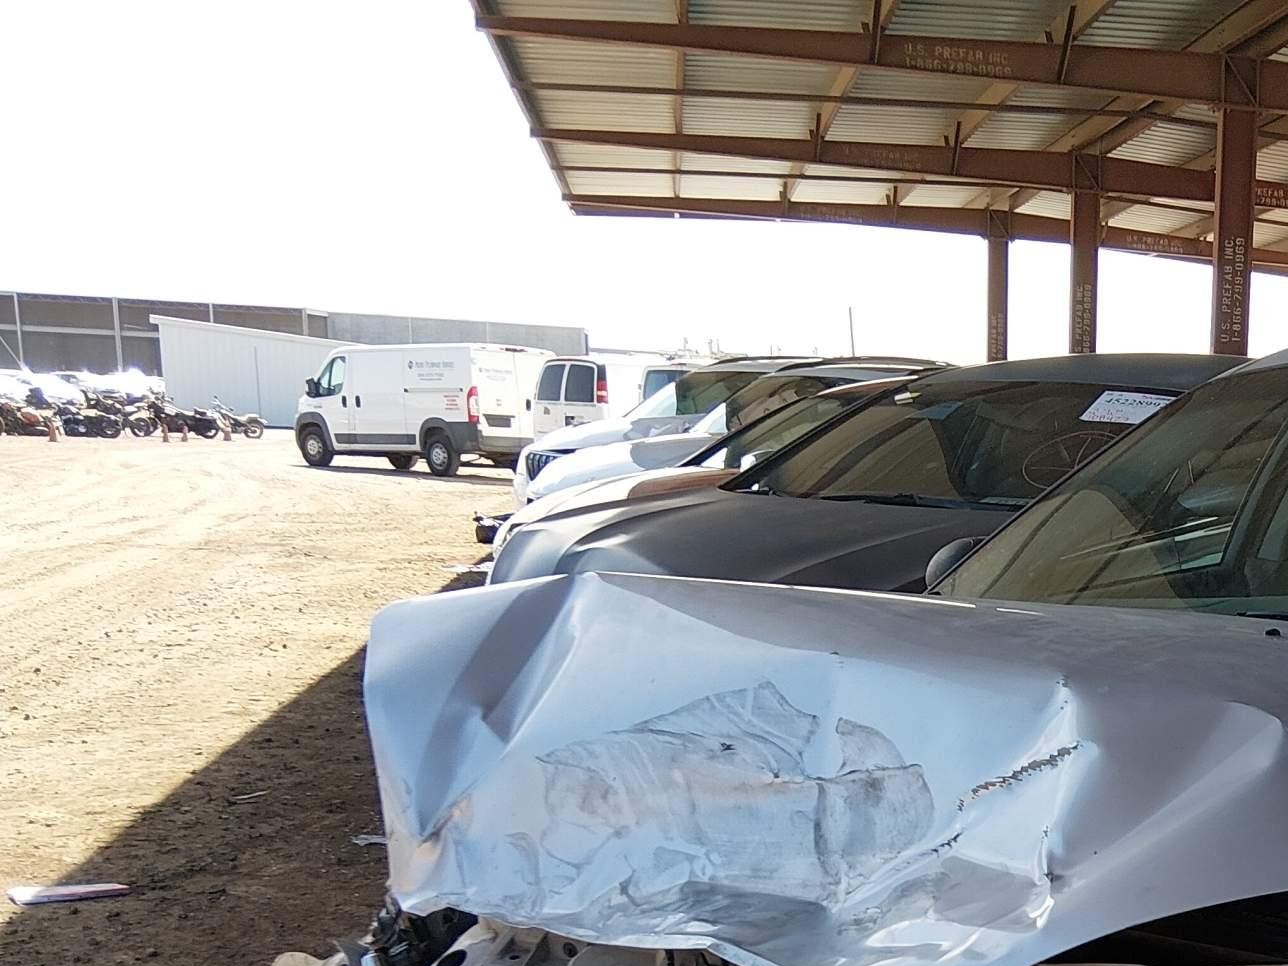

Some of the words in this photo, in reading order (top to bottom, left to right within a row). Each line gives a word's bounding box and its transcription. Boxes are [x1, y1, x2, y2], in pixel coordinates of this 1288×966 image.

[904, 43, 928, 57] U.S.
[935, 46, 983, 62] PREFAB
[1222, 265, 1233, 313] PREFAB
[1220, 319, 1231, 342] U.S.
